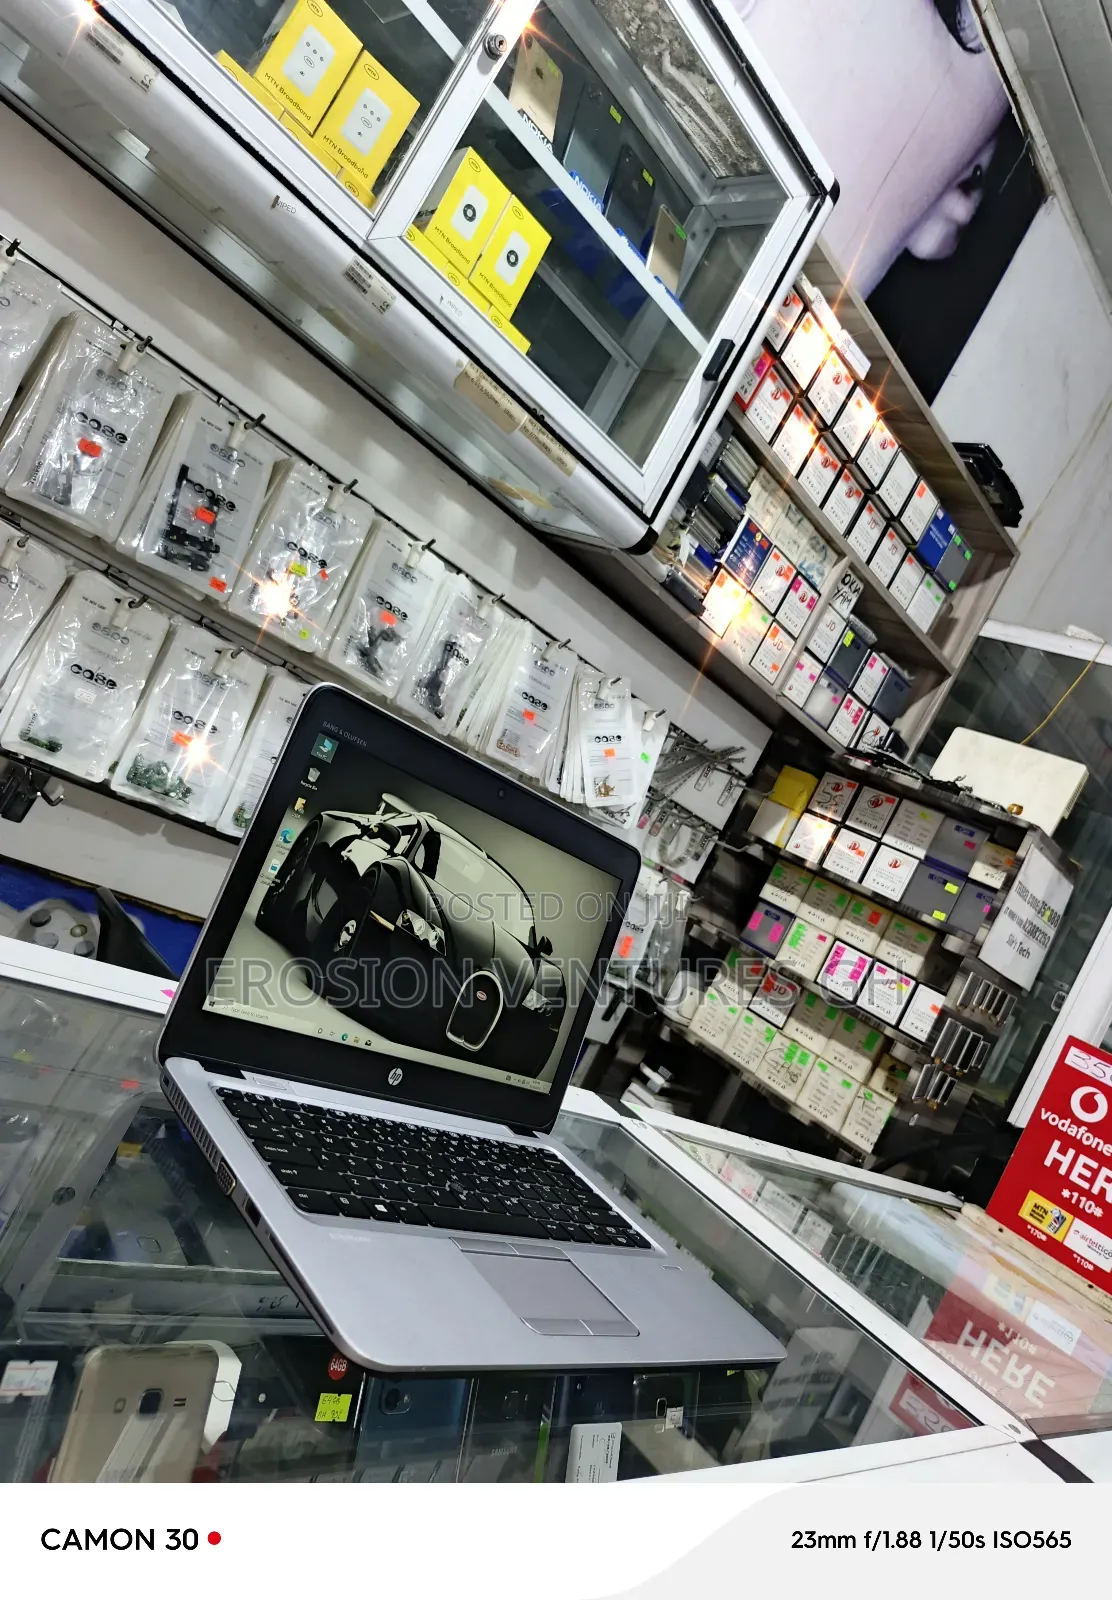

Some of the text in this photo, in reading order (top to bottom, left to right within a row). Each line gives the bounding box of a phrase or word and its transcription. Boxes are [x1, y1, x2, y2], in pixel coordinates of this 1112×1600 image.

[264, 72, 280, 89] MTN
[322, 134, 338, 151] MTN
[522, 114, 554, 154] NOKIA
[573, 175, 604, 213] NOKIA
[434, 225, 447, 239] MTN
[478, 272, 490, 285] MTN
[76, 411, 128, 444] case
[194, 482, 237, 511] case
[287, 541, 328, 569] case
[376, 596, 409, 621] case
[826, 619, 837, 632] JD
[772, 638, 784, 651] JD
[70, 663, 117, 690] case
[522, 691, 548, 711] case
[173, 710, 218, 734] case
[321, 720, 338, 732] BANG
[342, 731, 368, 746] OLUFSEN
[595, 735, 622, 743] case
[1016, 941, 1031, 959] Tech
[882, 978, 898, 990] JD
[390, 1071, 401, 1085] hp
[1040, 1108, 1112, 1157] vodafone
[1033, 1202, 1049, 1217] MTN
[330, 1358, 347, 1372] 64GB
